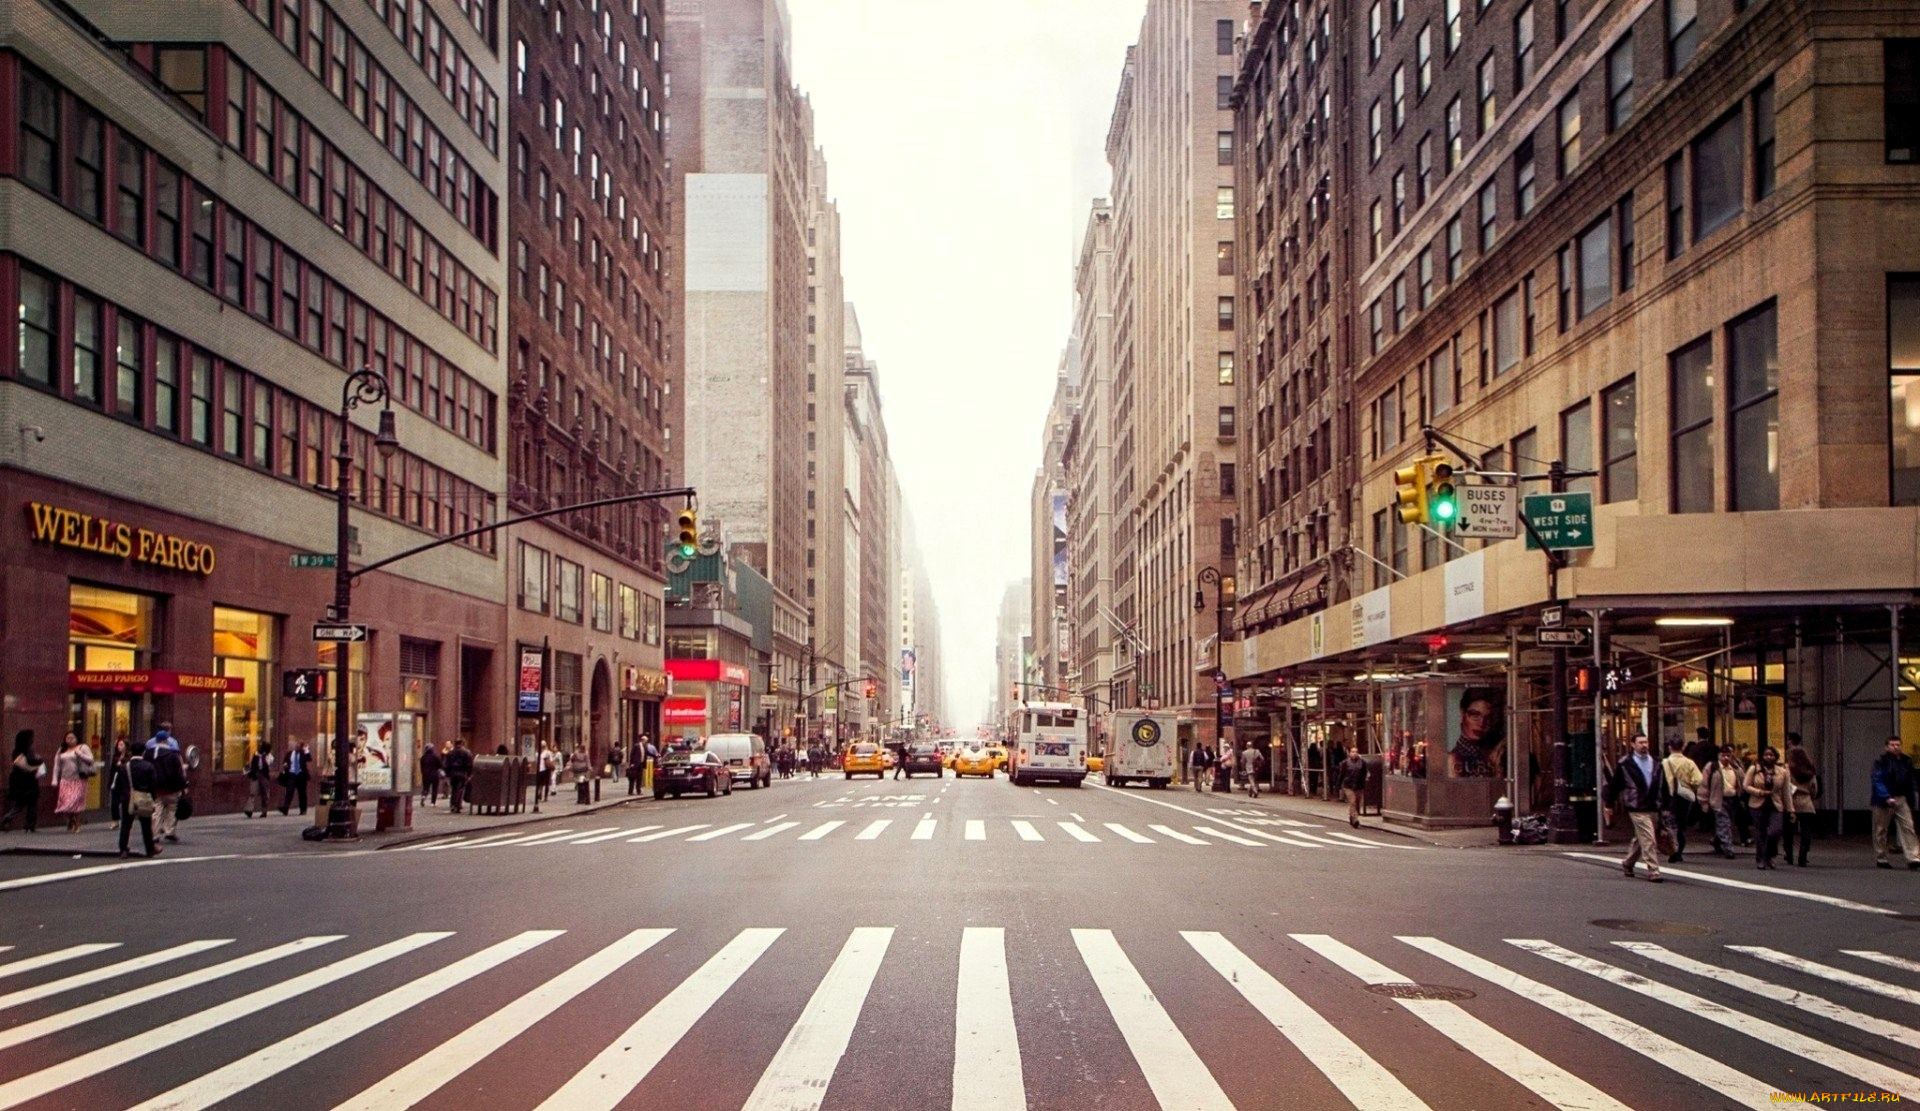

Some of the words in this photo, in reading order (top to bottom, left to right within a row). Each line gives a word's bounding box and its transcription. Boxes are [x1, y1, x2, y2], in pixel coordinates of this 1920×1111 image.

[1467, 489, 1506, 501] BUSES
[1470, 503, 1501, 514] ONLY
[1552, 502, 1564, 510] 9A
[1533, 516, 1559, 527] WEST
[1565, 514, 1587, 525] SIDE
[1502, 525, 1514, 533] FRI
[31, 501, 132, 558] WELLS
[137, 527, 216, 576] FARGO
[1538, 530, 1560, 540] HWY
[300, 555, 309, 567] W
[311, 555, 324, 567] 39
[1545, 632, 1559, 640] ONE
[1566, 632, 1581, 640] WAY
[78, 675, 112, 683] WELLS
[115, 675, 149, 683] FARGO
[178, 676, 204, 687] WELLS
[204, 677, 228, 690] FARGO
